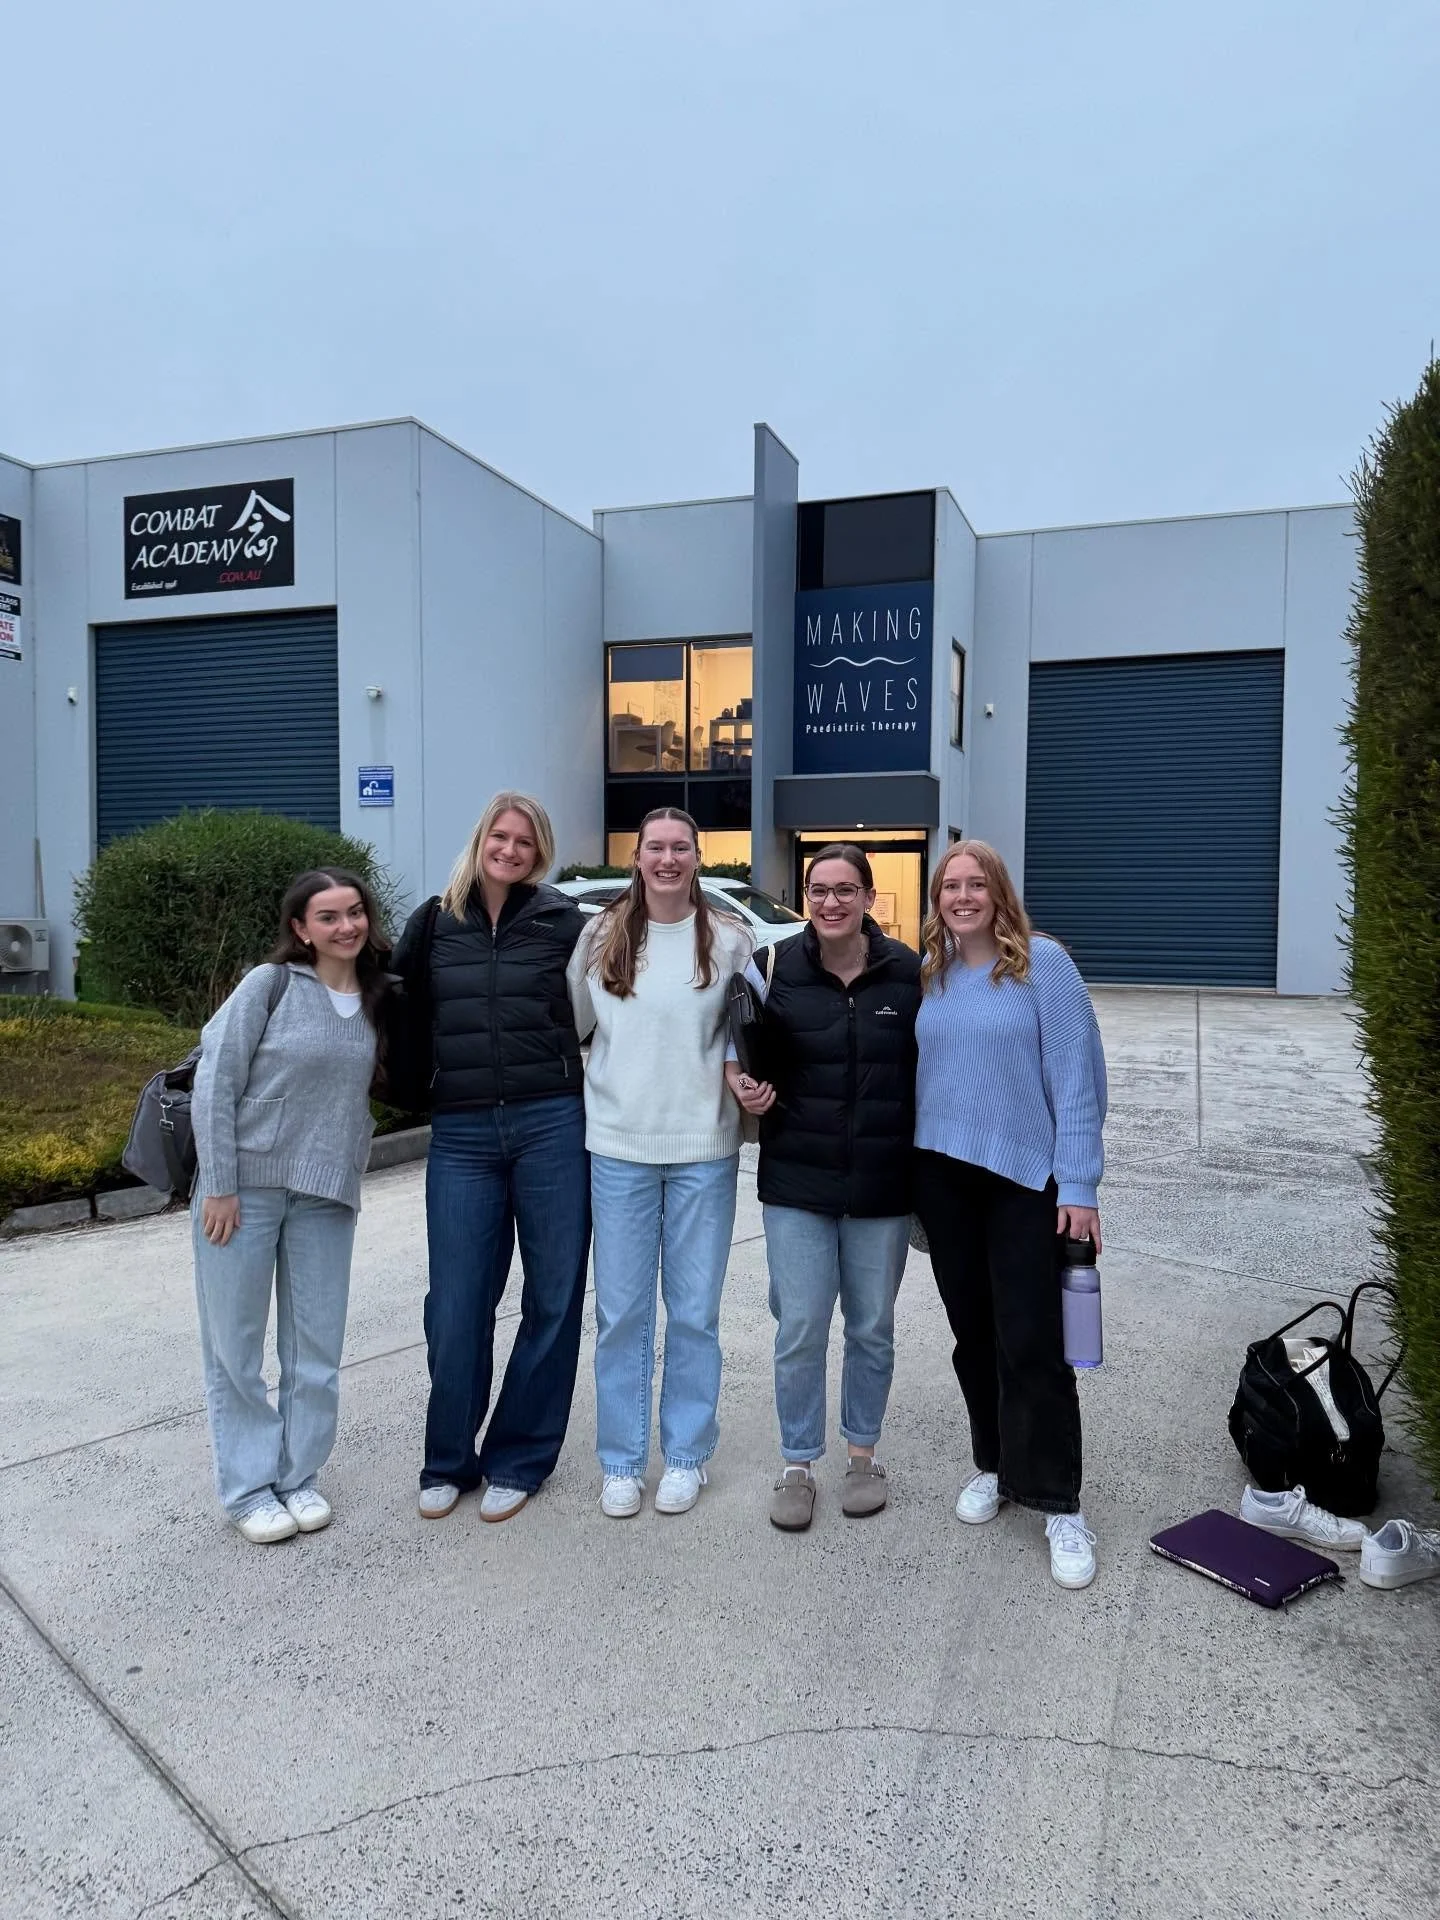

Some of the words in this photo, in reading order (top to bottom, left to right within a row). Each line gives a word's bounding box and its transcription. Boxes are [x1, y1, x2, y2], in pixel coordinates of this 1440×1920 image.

[130, 504, 223, 536] COMBAT
[131, 537, 243, 571] ACADEMY
[807, 607, 921, 645] MAKING
[806, 677, 918, 715] WAVES
[806, 721, 865, 733] Paediatric
[871, 720, 917, 732] Therapy
